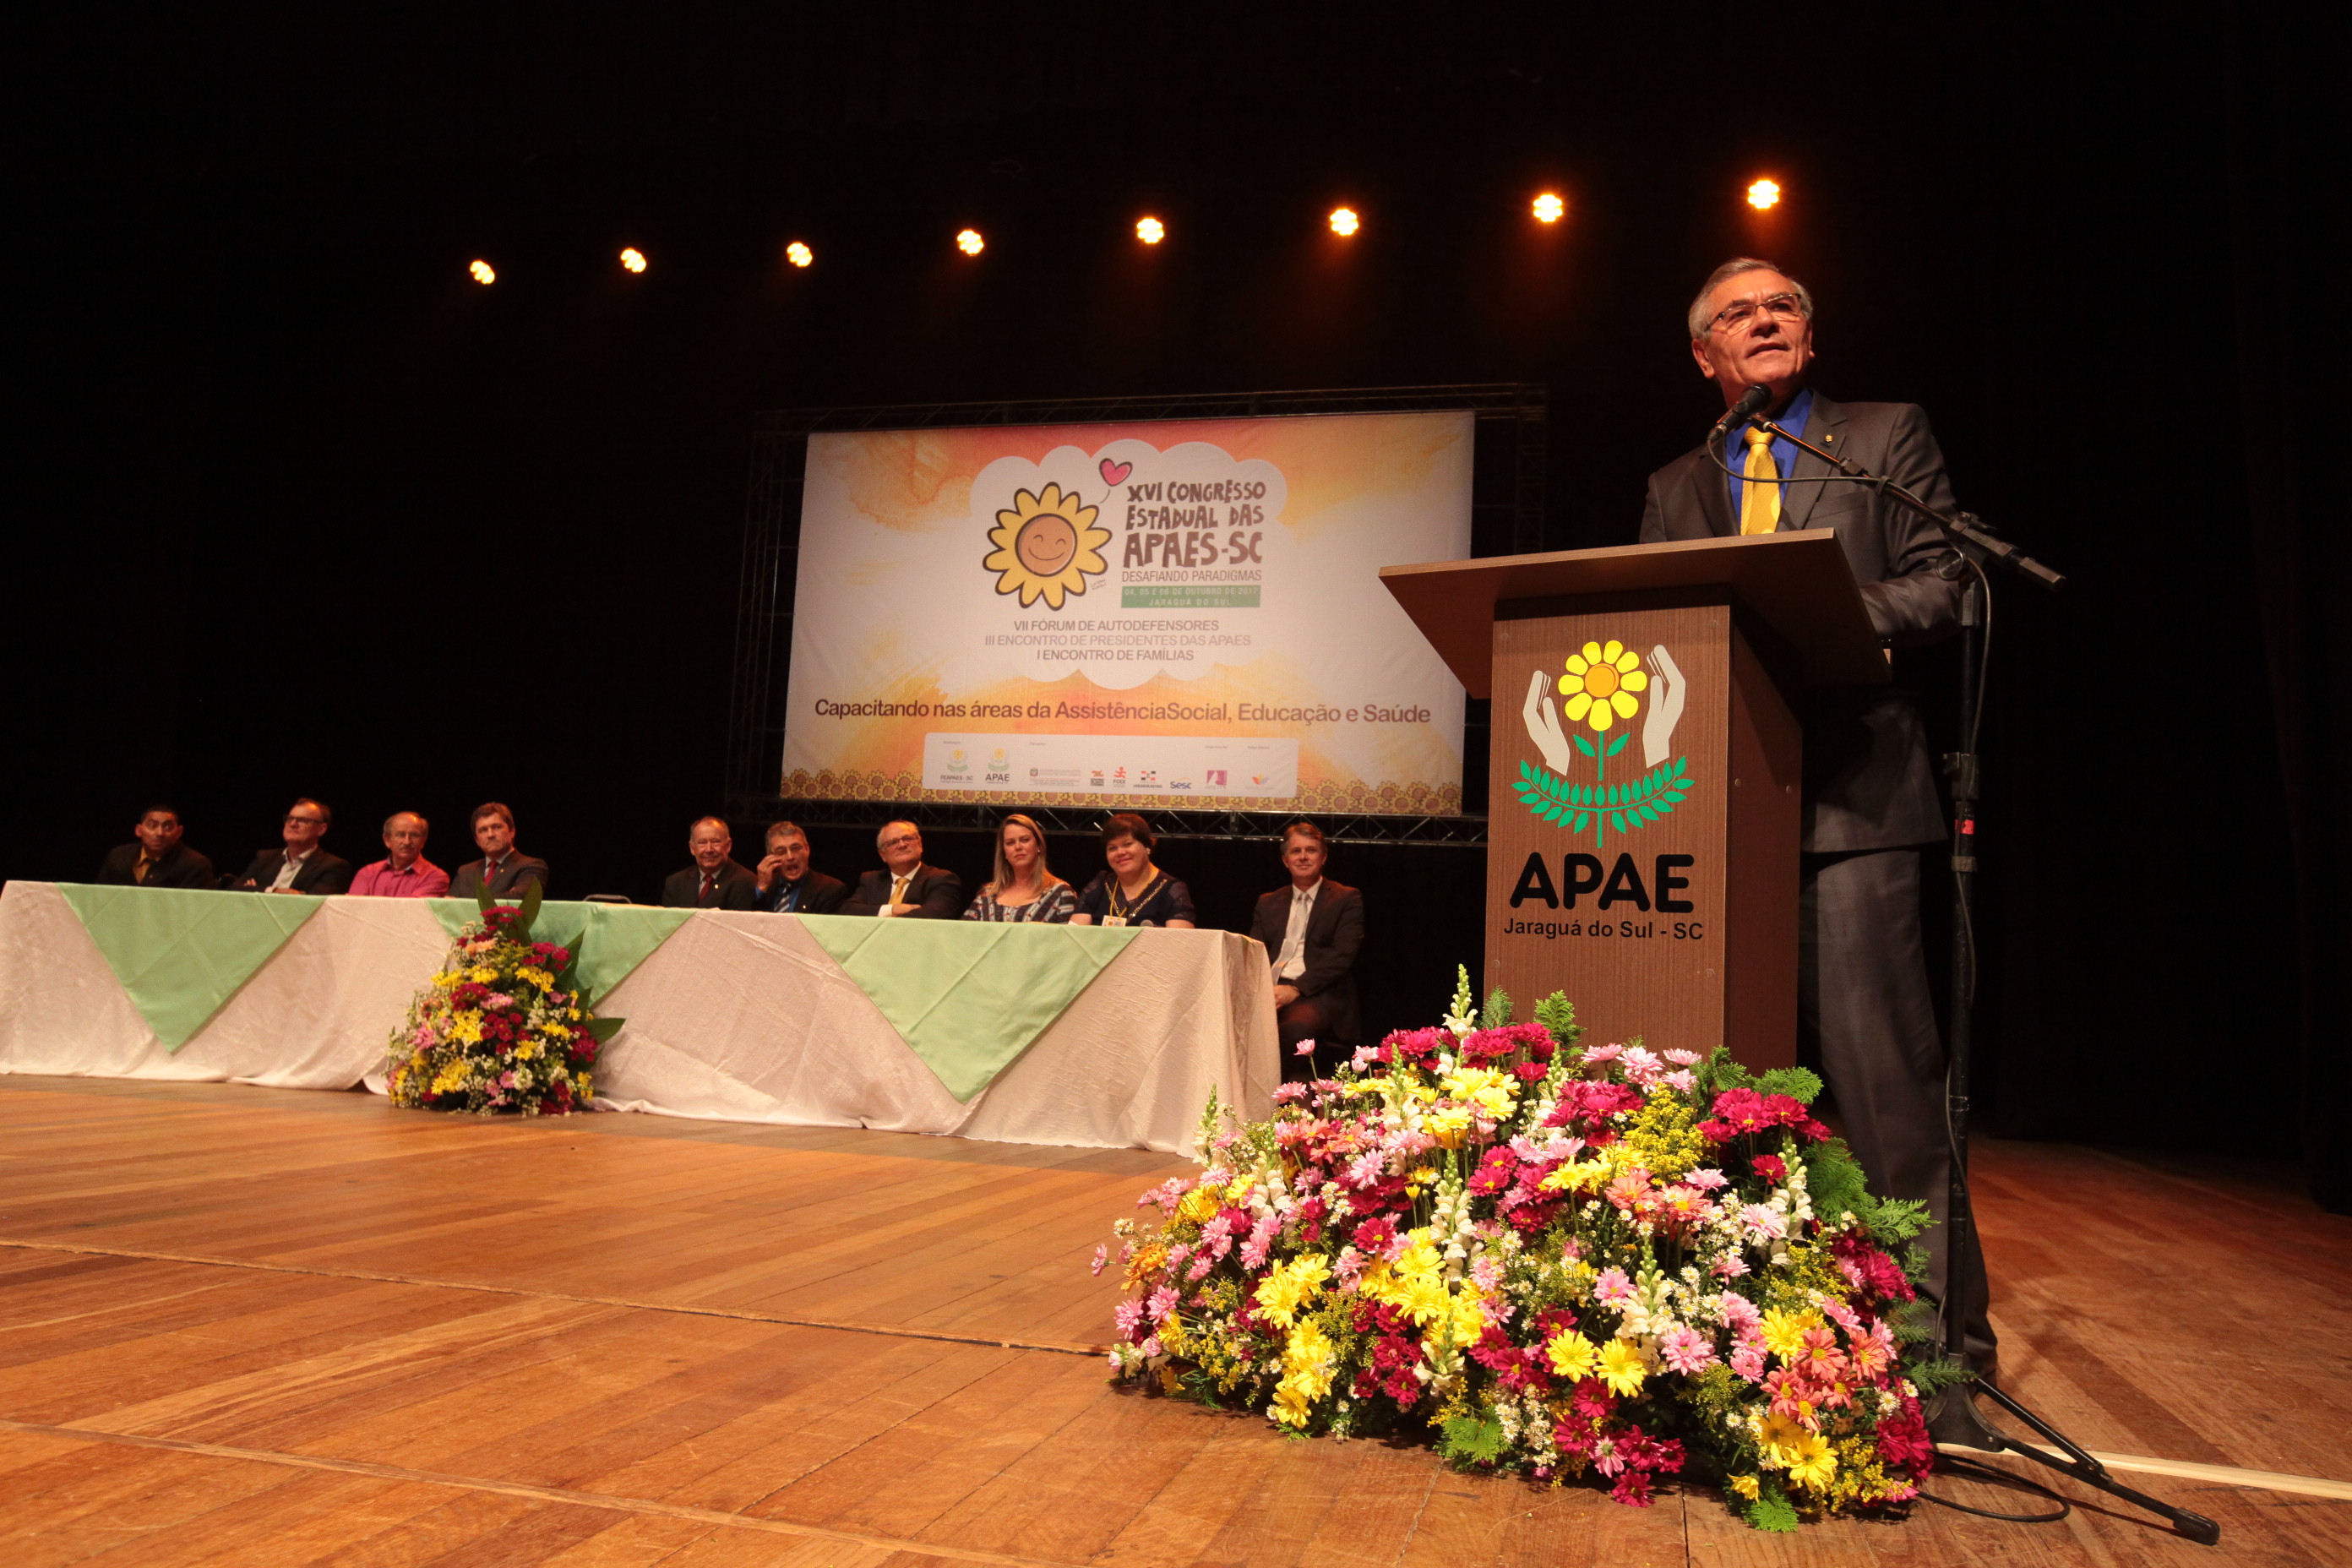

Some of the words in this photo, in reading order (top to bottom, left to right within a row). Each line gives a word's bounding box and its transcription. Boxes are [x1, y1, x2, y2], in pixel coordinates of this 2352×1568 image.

[1127, 482, 1162, 503] XVI
[1167, 479, 1266, 504] CONGRESSO
[1125, 505, 1218, 531] ESTADUAL
[1228, 504, 1265, 527] DAS
[1123, 531, 1263, 569] APAES-SC
[1122, 570, 1188, 582] DESAFIANDO
[1192, 569, 1262, 581] PARADIGMAS
[1148, 597, 1191, 607] JARAGUÁ
[1214, 597, 1231, 606] SUL
[1014, 621, 1028, 631] VII
[1031, 618, 1075, 631] FÓRUM
[1078, 621, 1095, 631] DE
[1097, 620, 1219, 631] AUTODEFENSORES
[985, 635, 994, 645] III
[998, 635, 1068, 645] ENCONTRO
[1070, 635, 1086, 645] DE
[1089, 635, 1177, 645] PRESIDENTES
[1180, 635, 1206, 645] DAS
[1209, 634, 1251, 645] APAES
[1043, 650, 1113, 660] ENCONTRO
[1117, 650, 1134, 660] DE
[1136, 647, 1195, 661] FAMÍLIAS
[814, 699, 929, 719] Capacitando
[933, 704, 966, 717] nas
[971, 700, 1022, 718] áreas
[1026, 701, 1051, 718] da
[1239, 703, 1342, 726] Educação
[1346, 708, 1358, 721] e
[1364, 704, 1431, 723] Saúde
[985, 773, 1010, 781] APAE
[1509, 852, 1695, 913] APAE
[1504, 918, 1582, 939] Jaraguá
[1588, 920, 1614, 937] do
[1620, 921, 1652, 939] Sul
[1673, 923, 1703, 940] SC
